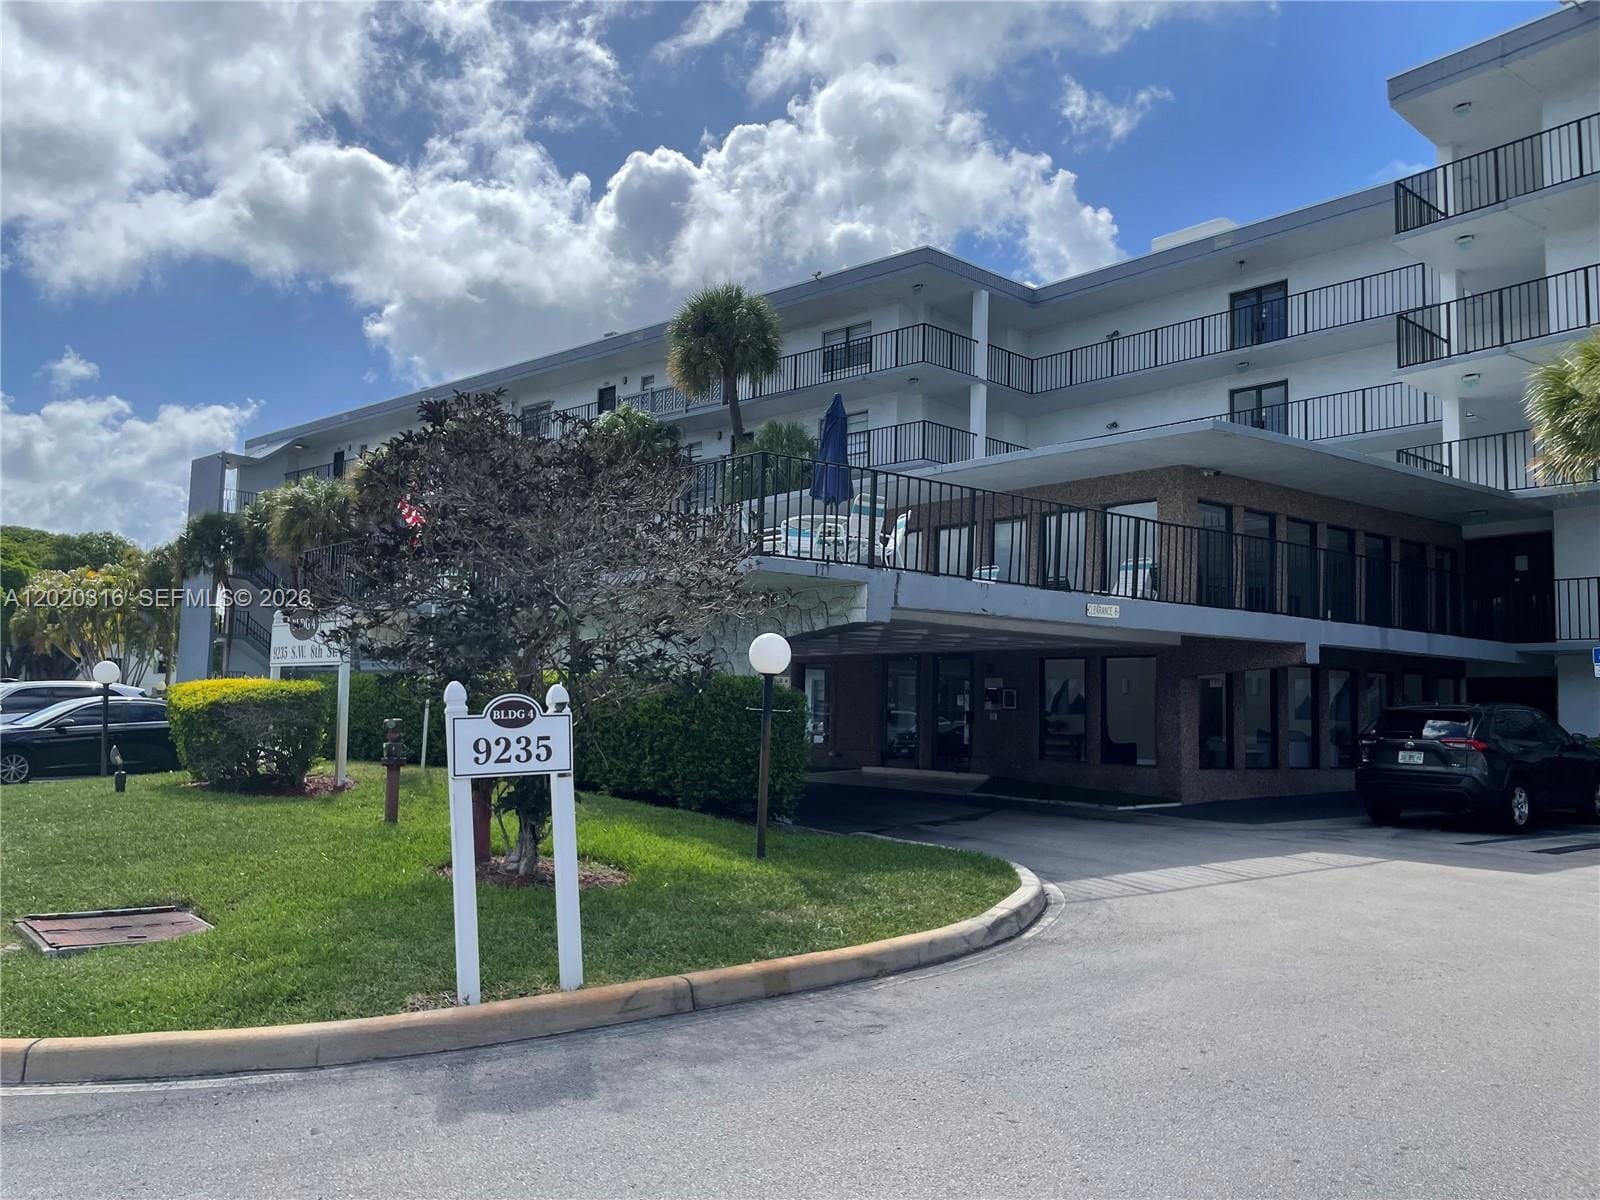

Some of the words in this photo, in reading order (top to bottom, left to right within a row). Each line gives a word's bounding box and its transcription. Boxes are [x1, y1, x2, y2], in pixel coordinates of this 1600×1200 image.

[1088, 605, 1113, 616] CLEARANCE
[273, 646, 288, 660] 9235
[291, 645, 306, 659] S.W.
[310, 644, 323, 658] 8th
[493, 709, 525, 720] BLDG
[527, 709, 534, 719] 4
[473, 735, 552, 765] 9235
